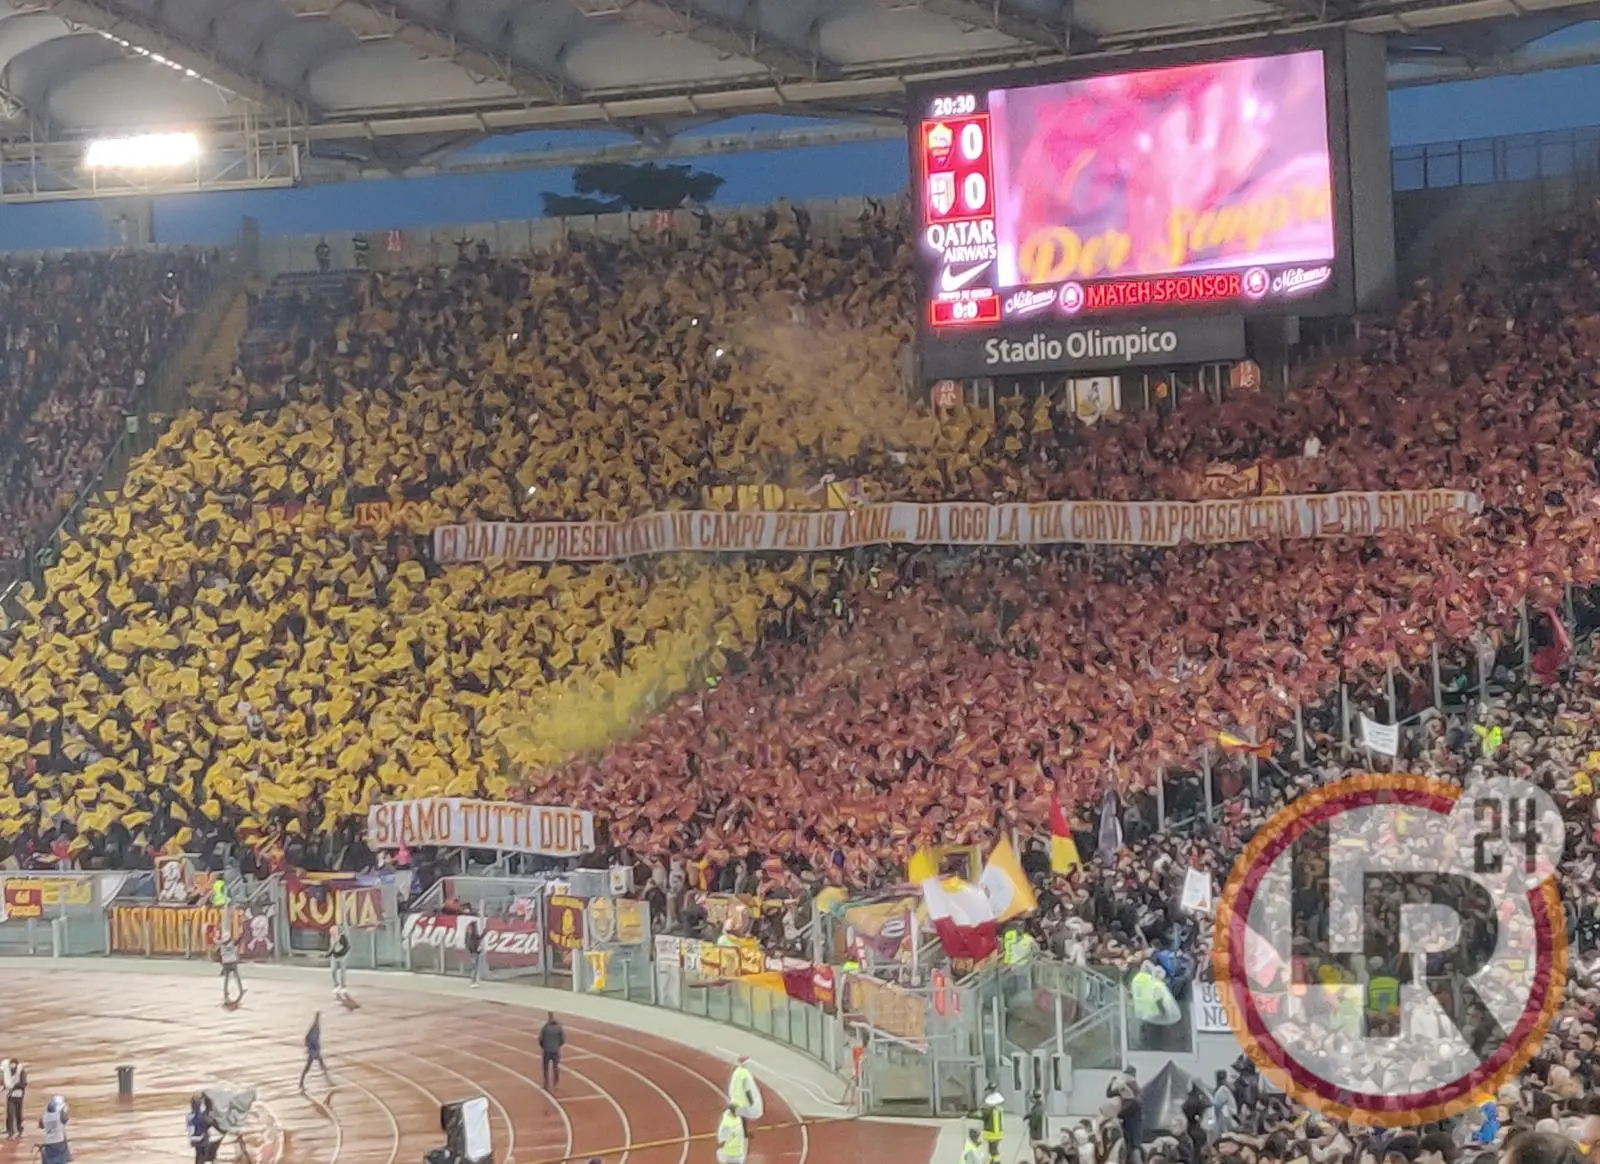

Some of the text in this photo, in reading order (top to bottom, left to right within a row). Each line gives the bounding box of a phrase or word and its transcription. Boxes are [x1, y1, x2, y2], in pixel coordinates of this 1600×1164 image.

[934, 95, 975, 115] 20:30
[962, 123, 983, 161] 0
[965, 172, 986, 210] 0
[927, 219, 995, 253] QATAR
[943, 243, 997, 262] AIRWAYS
[1087, 284, 1150, 308] MATCH
[1153, 275, 1240, 302] SPONSOR
[985, 326, 1177, 365] Stadio Olimpico
[441, 527, 458, 559] CI
[466, 525, 498, 558] HAI
[503, 514, 665, 558] RAPPRESENTATO
[671, 512, 693, 547] IN
[700, 512, 765, 547] CAMPO
[774, 513, 810, 547] PER
[817, 513, 836, 547] 18
[915, 507, 941, 541] DA
[950, 506, 990, 541] OGGI
[997, 506, 1020, 541] LA
[1028, 504, 1064, 540] TUA
[1071, 503, 1133, 541] CURVA
[1336, 494, 1371, 534] PER
[376, 801, 583, 851] SIAMO TUTTI DDR
[289, 890, 379, 926] ROMA
